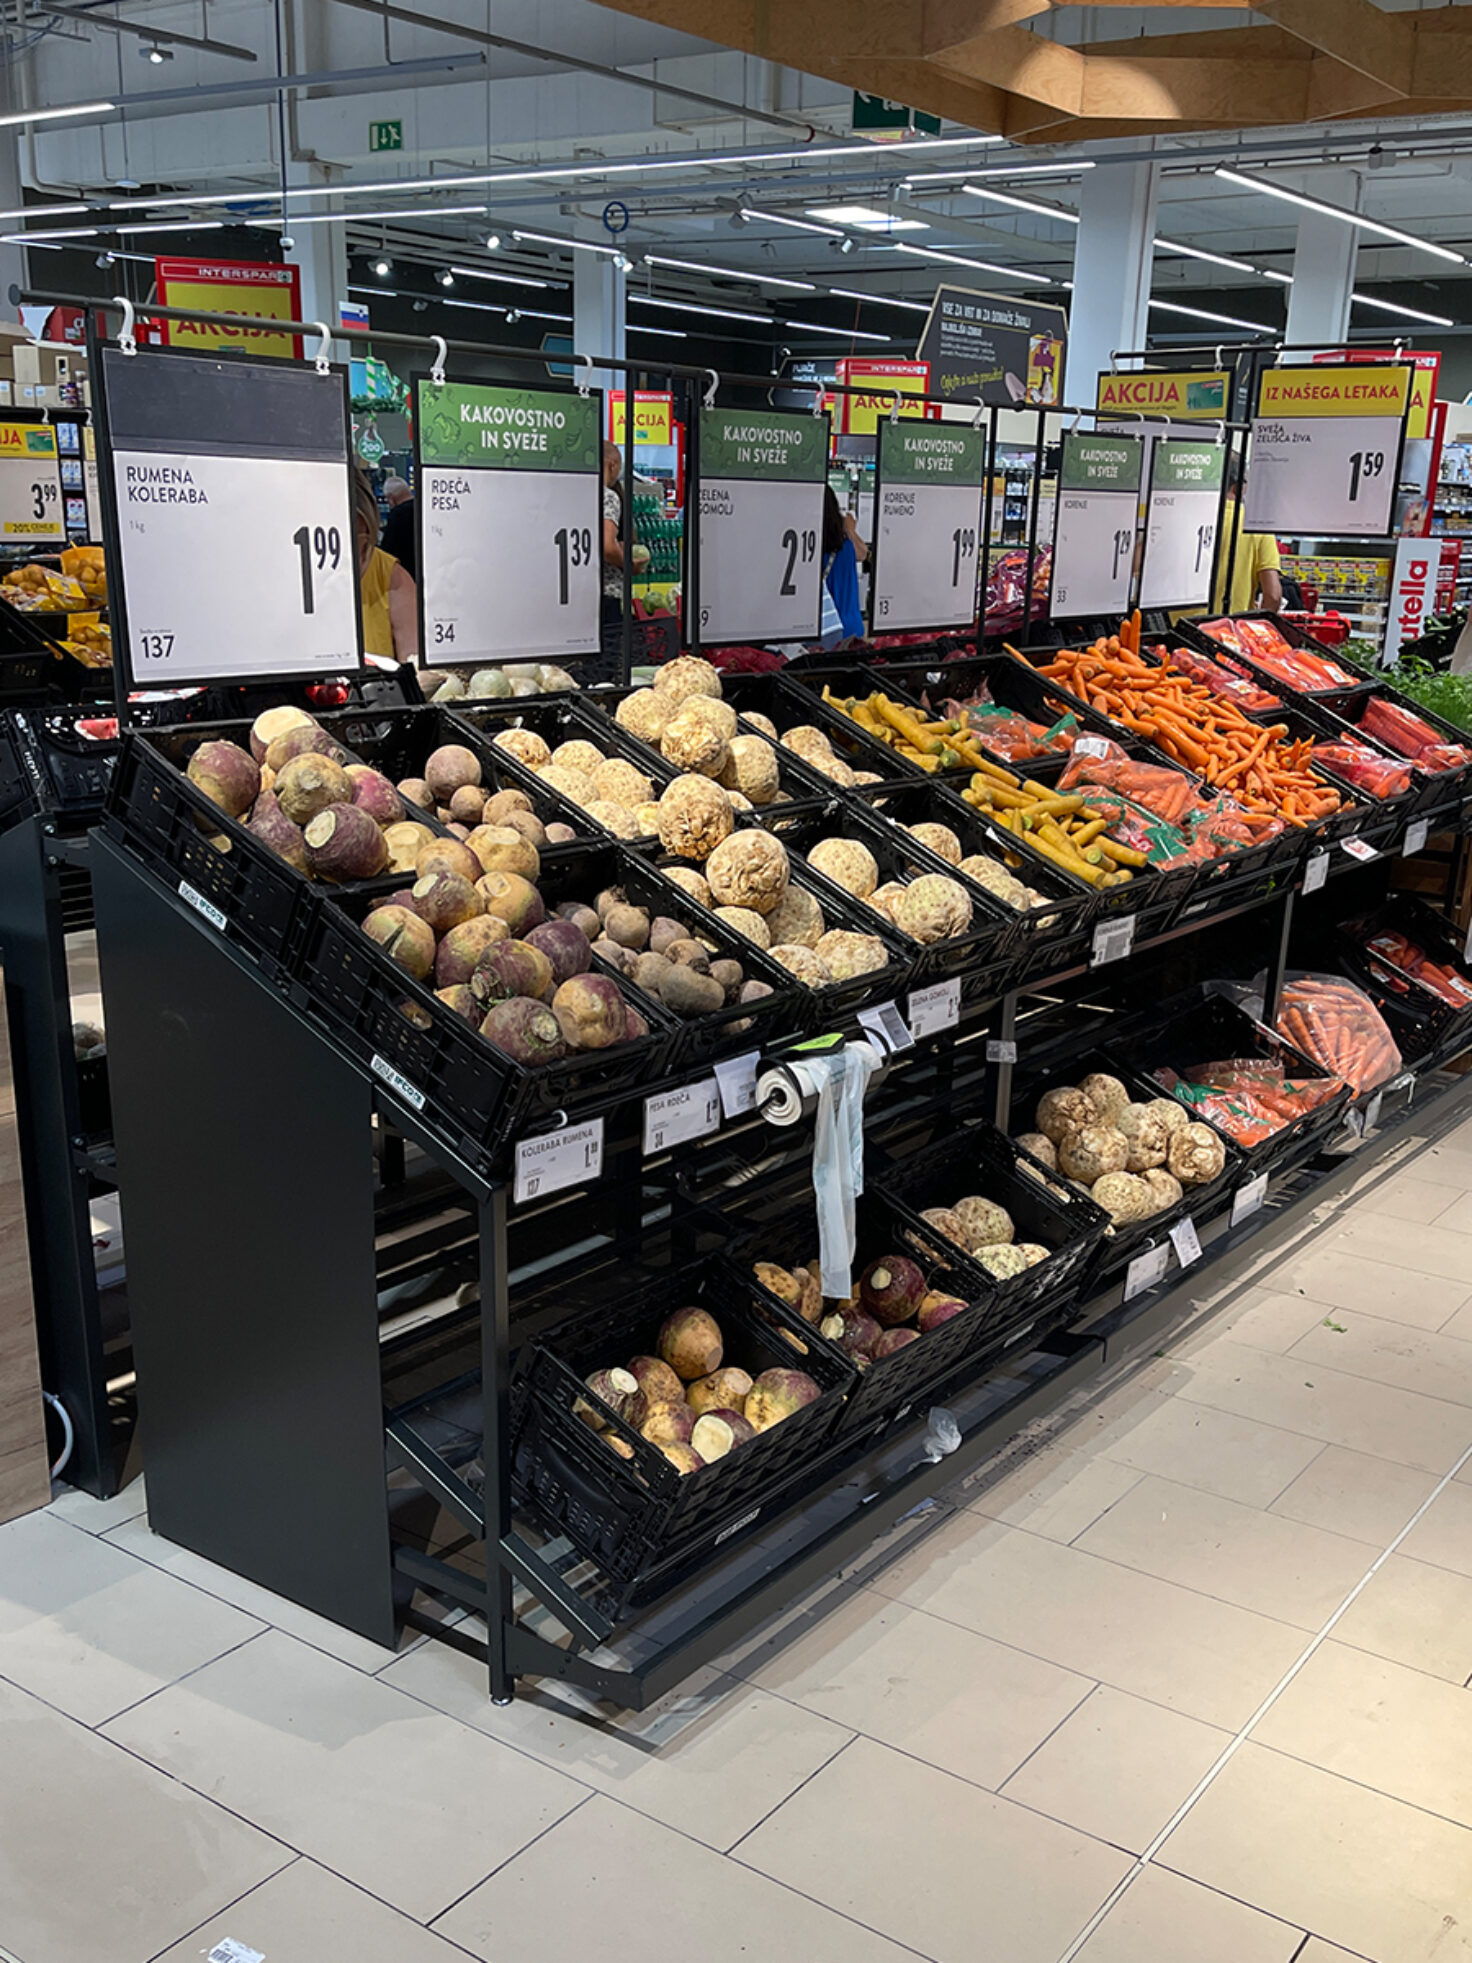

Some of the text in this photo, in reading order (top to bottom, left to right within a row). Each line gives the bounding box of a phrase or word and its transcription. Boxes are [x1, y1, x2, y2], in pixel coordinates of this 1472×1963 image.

[199, 268, 277, 280] INTERSPAR
[1101, 381, 1180, 405] AKCIJA
[1266, 386, 1278, 400] IZ
[1282, 382, 1340, 400] NAŠEGA
[1344, 385, 1399, 399] LETAKA
[855, 395, 919, 410] AKCJA
[460, 404, 565, 429] KAKOVOSTNO
[616, 413, 666, 426] ACIJA
[723, 425, 802, 443] KAKOVOSTNO
[1257, 423, 1284, 434] SVEŽA
[0, 429, 22, 445] JA
[481, 428, 547, 451] IN SVEŽE
[904, 438, 965, 454] KAKOVOSTNO
[737, 445, 788, 464] IN SVEŽE
[1080, 449, 1127, 463] KAKOVOSTNO
[1170, 453, 1211, 466] KAKOVOSTNO
[915, 455, 953, 471] IN SVEŽE
[1087, 463, 1119, 478] IN SVEŽE
[127, 466, 194, 484] RUMENA
[431, 477, 471, 495] RDEČA
[128, 486, 208, 504] KOLERABA
[699, 489, 730, 501] ELENA
[884, 493, 915, 504] KORENJE
[431, 497, 460, 511] PESA
[879, 601, 889, 615] 13
[1398, 560, 1428, 643] utella
[701, 610, 709, 627] 9
[434, 624, 455, 643] 34
[141, 635, 175, 658] 137
[521, 1138, 561, 1159] KOLERABA
